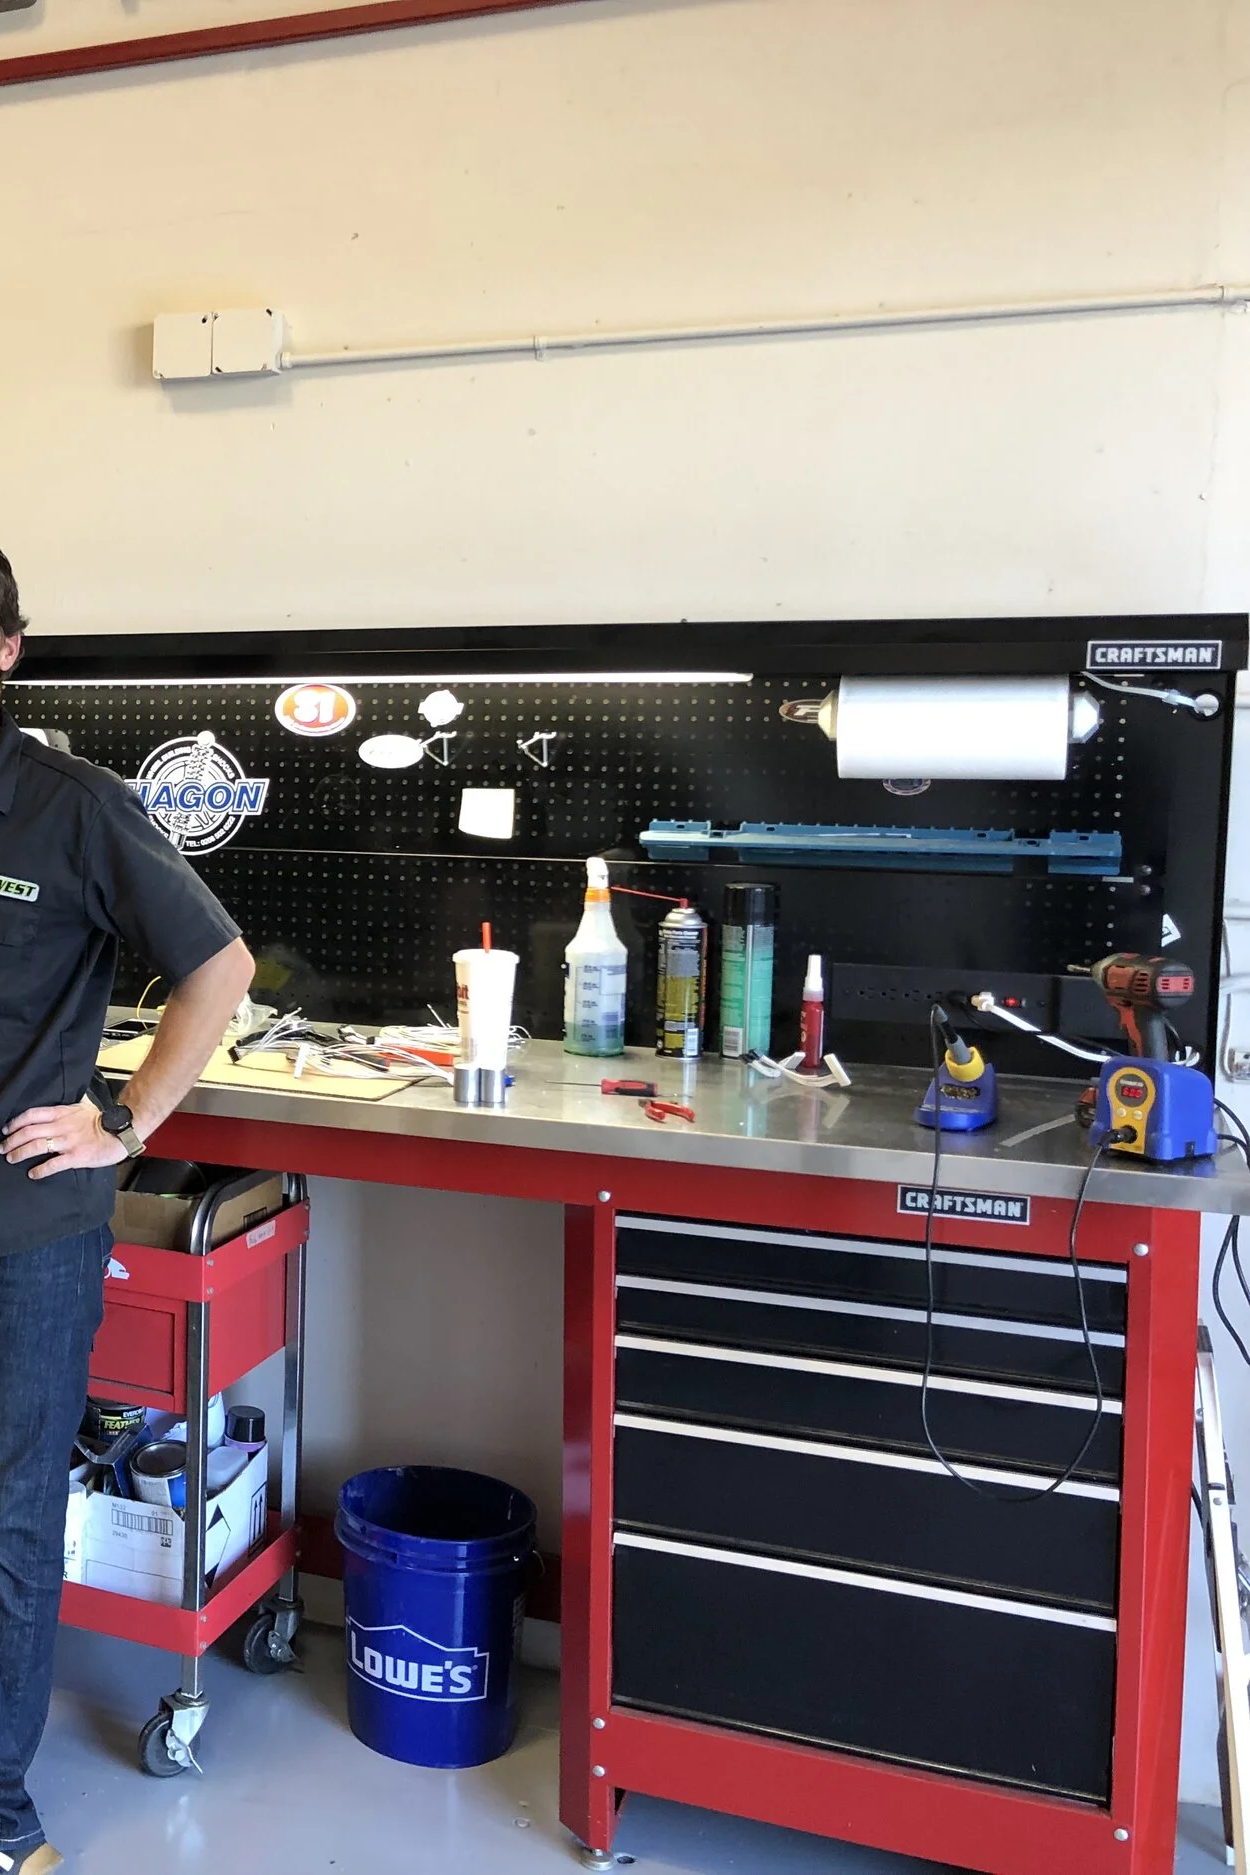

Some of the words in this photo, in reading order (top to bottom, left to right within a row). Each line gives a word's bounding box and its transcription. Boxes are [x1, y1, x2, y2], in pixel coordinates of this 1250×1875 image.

[1095, 647, 1213, 663] CRAFTSMAN
[293, 689, 337, 724] 81
[905, 1191, 1022, 1218] CRAFTSMAN
[351, 1630, 472, 1694] LOWE'S
